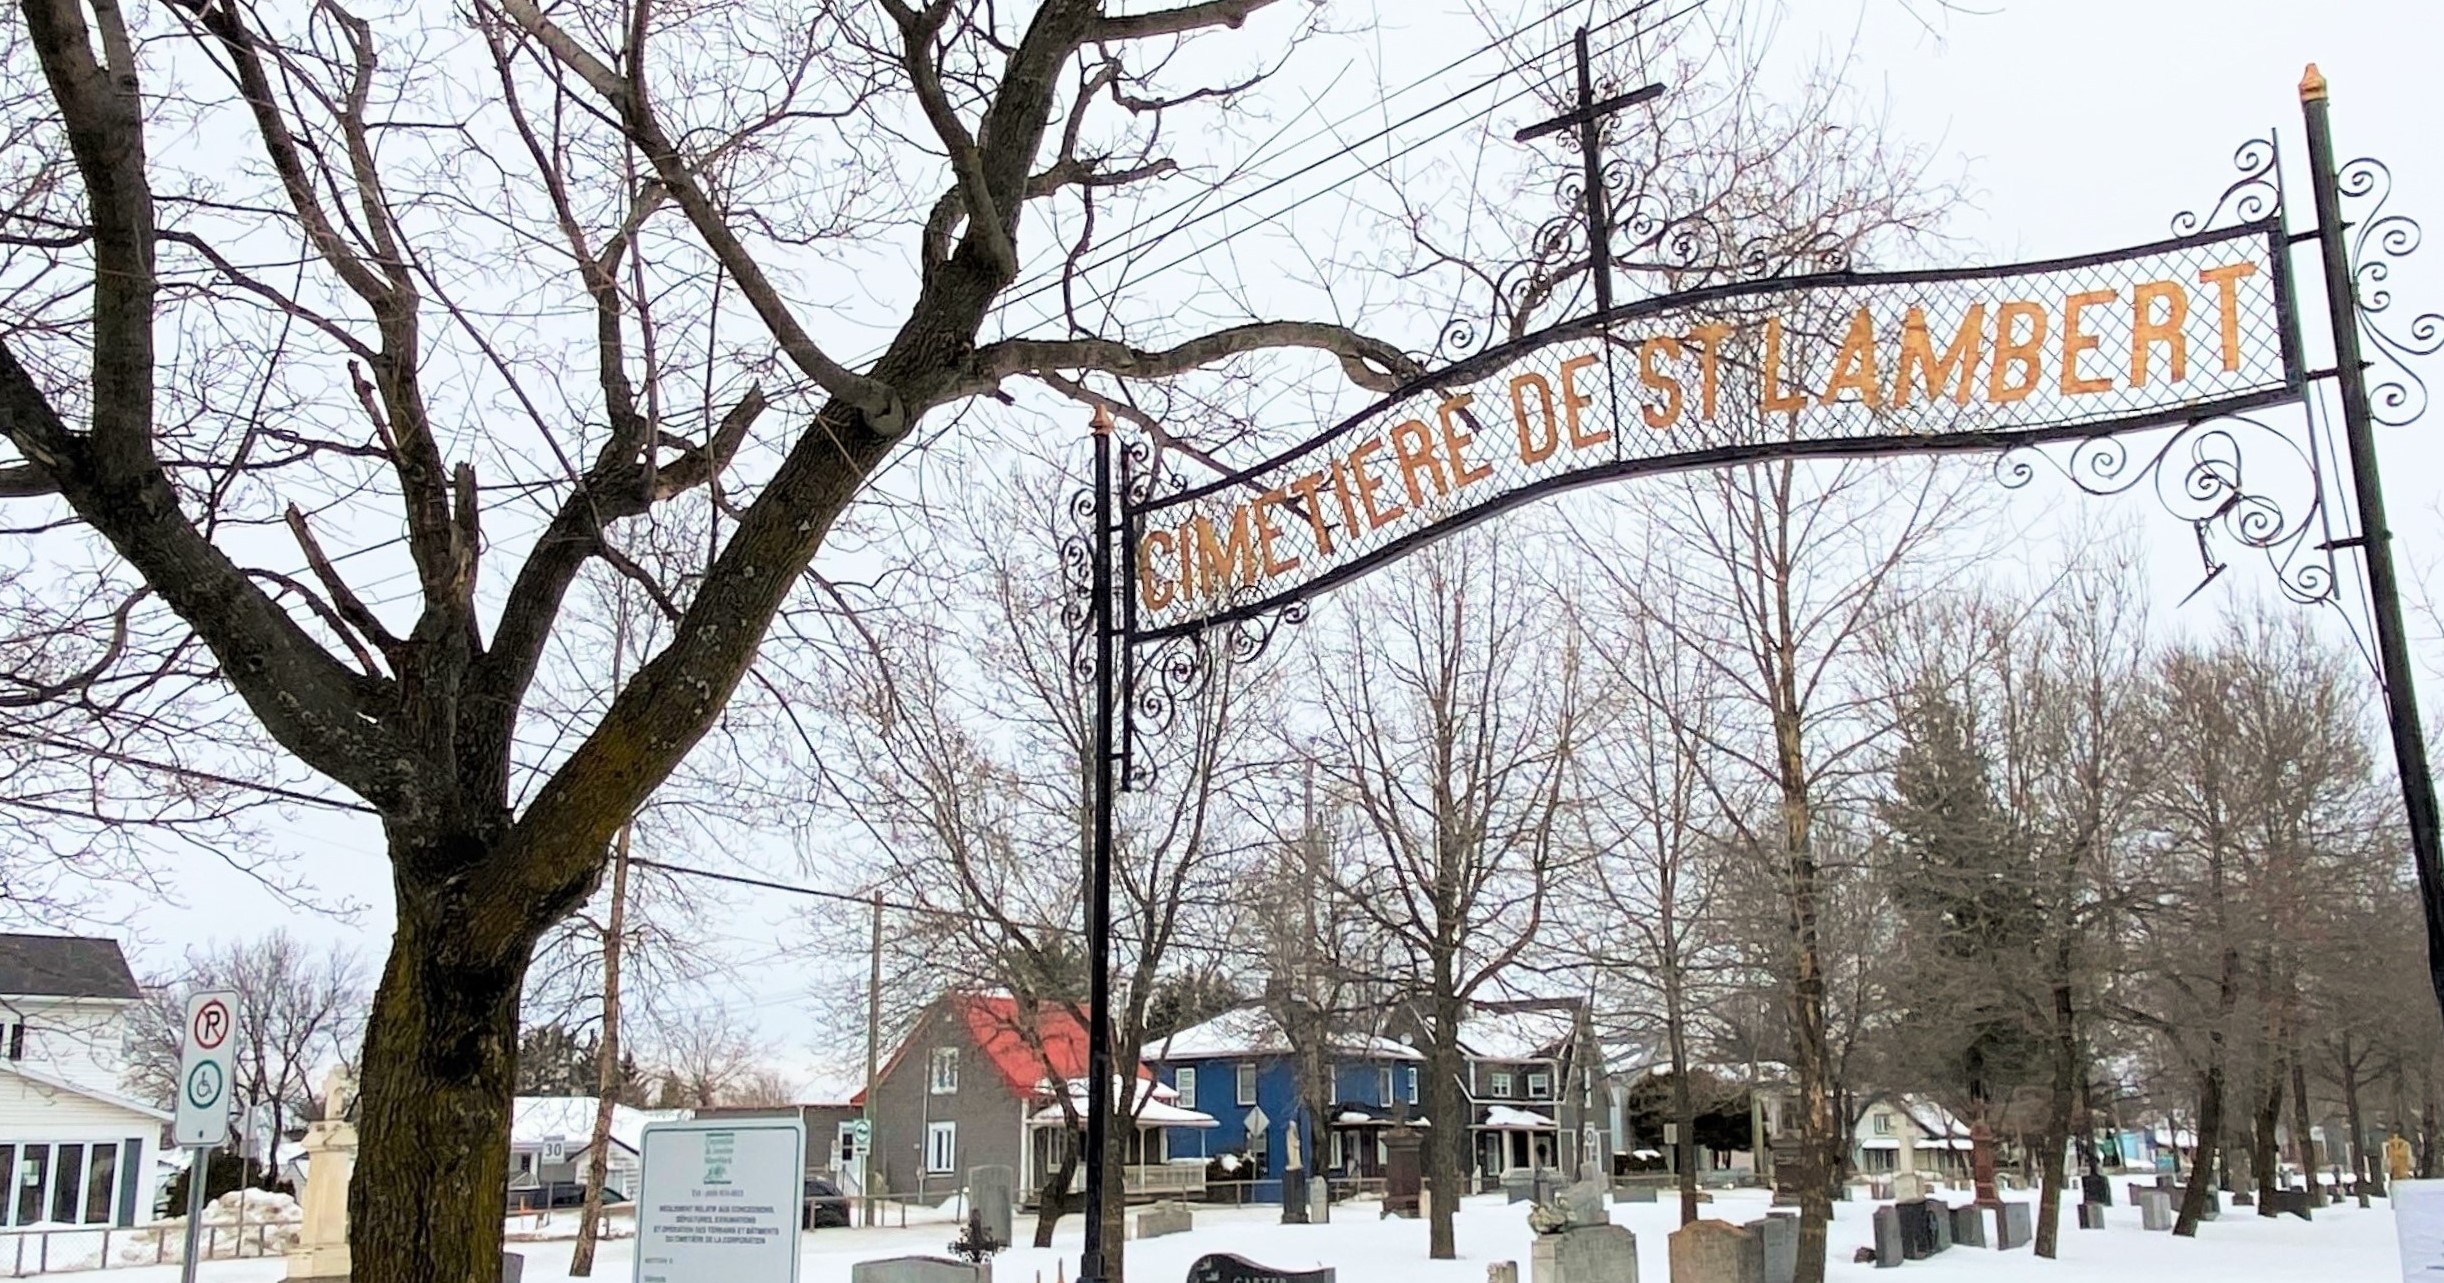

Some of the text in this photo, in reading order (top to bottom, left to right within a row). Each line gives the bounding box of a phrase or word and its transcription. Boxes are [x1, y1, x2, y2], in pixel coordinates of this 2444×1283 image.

[1139, 261, 2257, 611] CIMETIERE DE ST LAMBERT
[545, 1143, 562, 1157] 30
